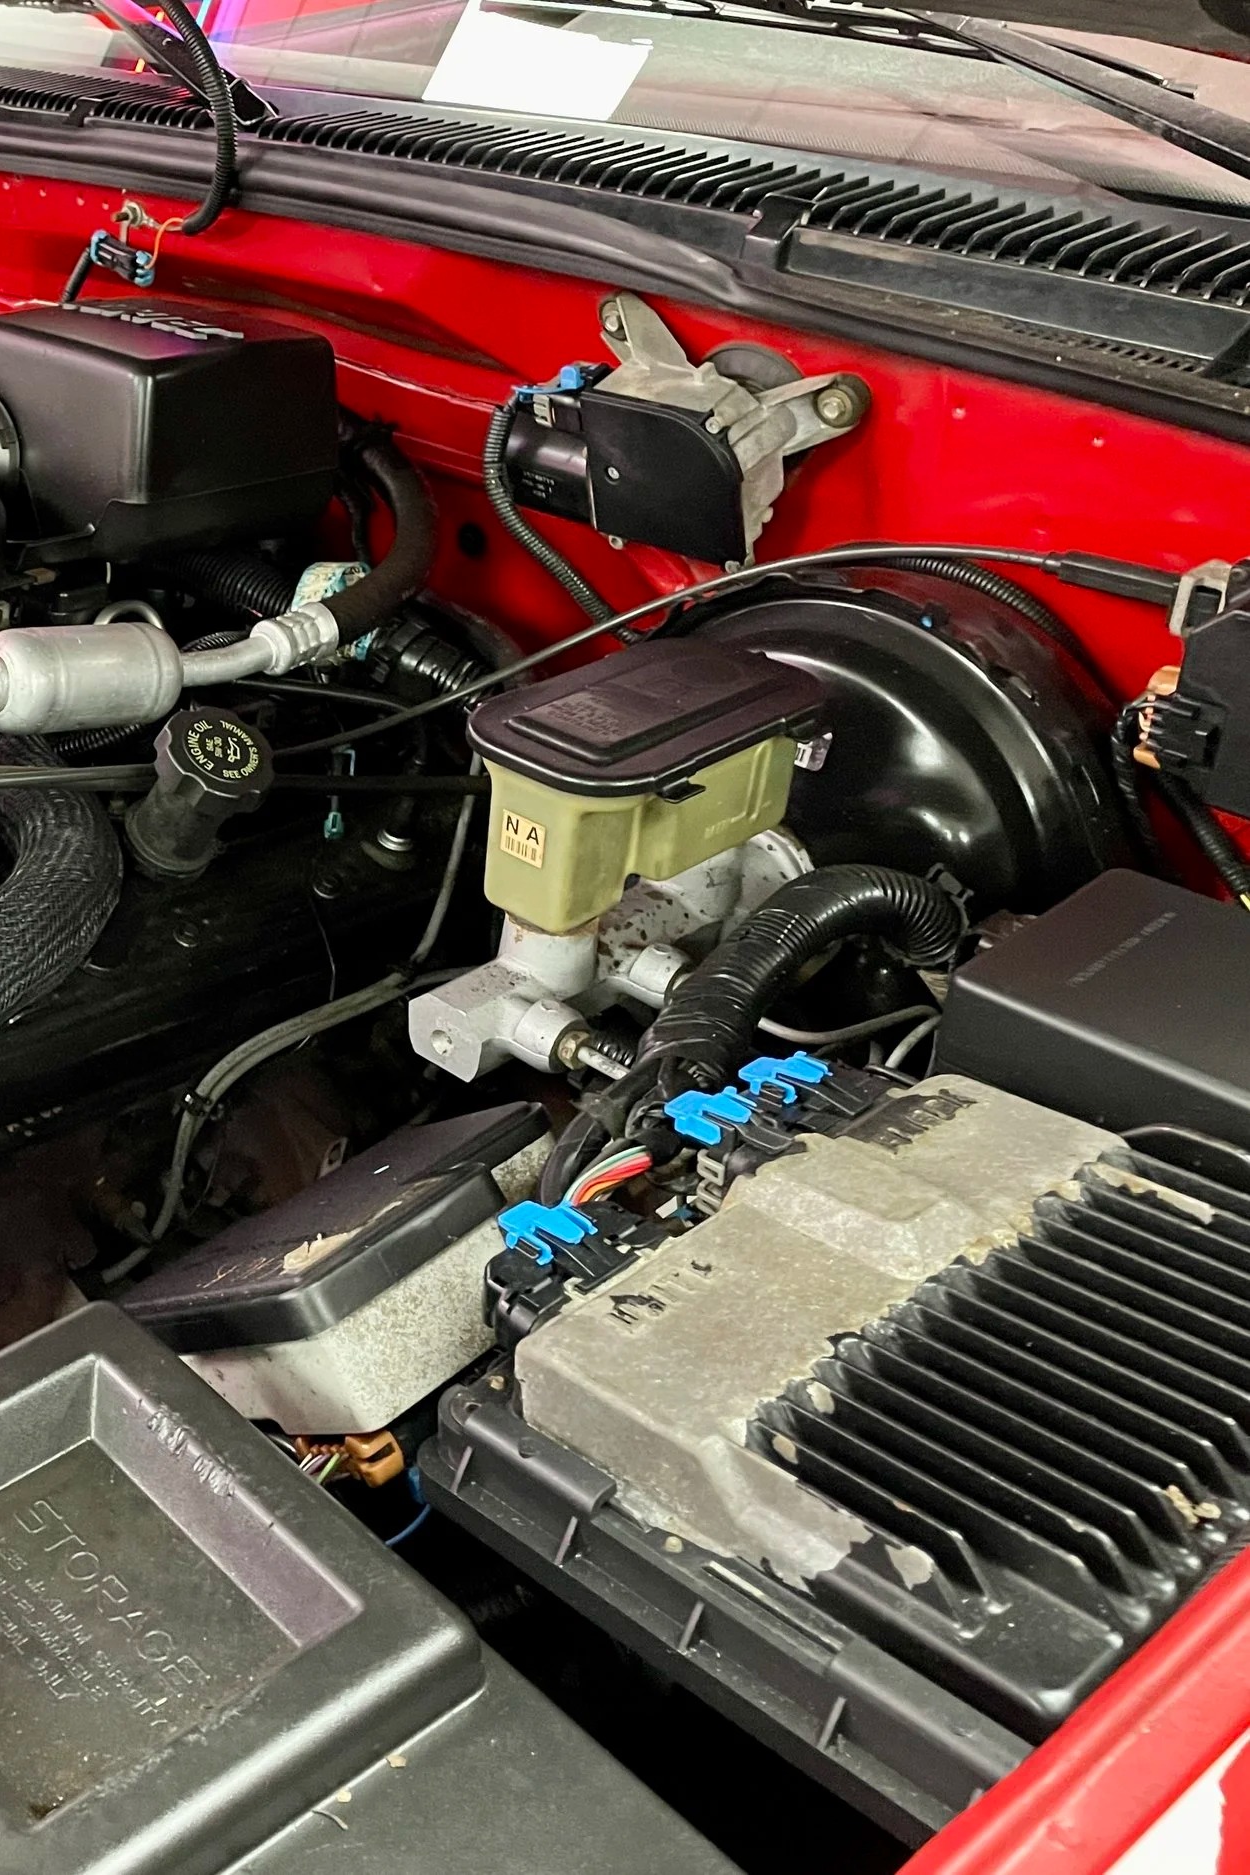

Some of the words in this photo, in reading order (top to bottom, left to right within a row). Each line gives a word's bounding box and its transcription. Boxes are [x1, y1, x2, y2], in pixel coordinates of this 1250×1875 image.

[193, 720, 213, 733] OIL
[220, 720, 254, 746] MANUAL
[187, 730, 214, 771] ENGINE
[222, 769, 241, 779] SEE
[14, 1500, 211, 1697] STORAGE
[30, 1657, 81, 1700] ONLY
